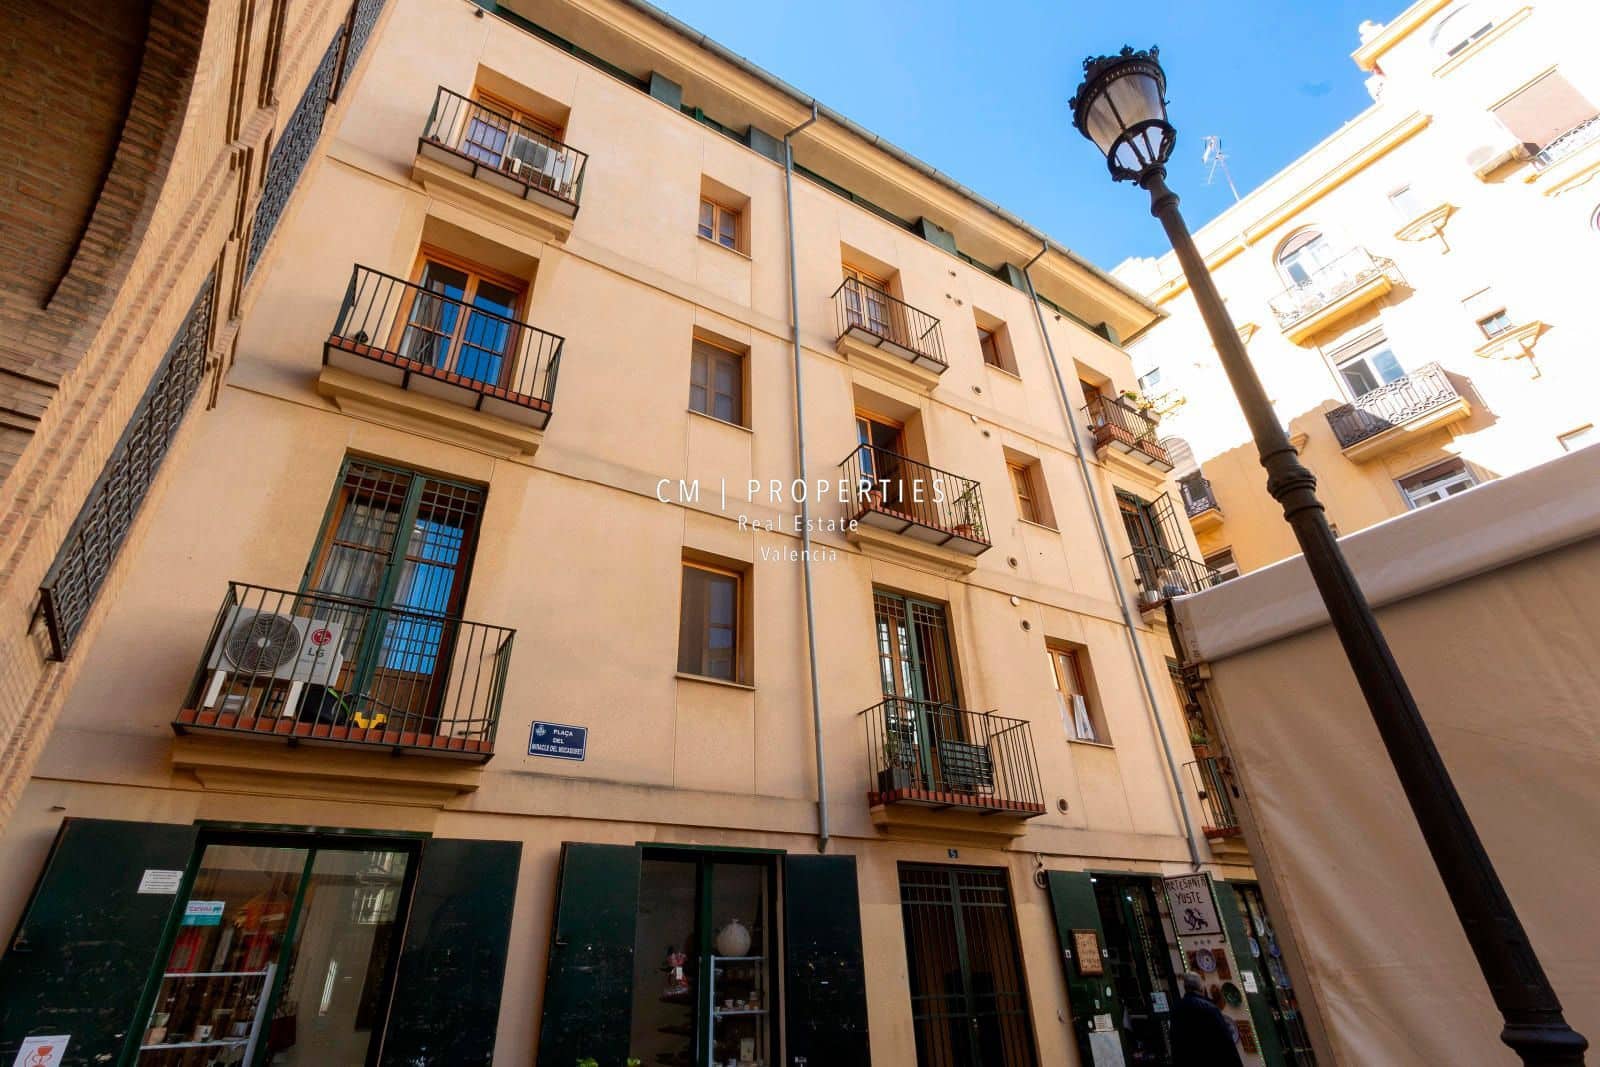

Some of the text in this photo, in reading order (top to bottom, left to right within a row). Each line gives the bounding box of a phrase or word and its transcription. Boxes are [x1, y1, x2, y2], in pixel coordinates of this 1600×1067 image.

[307, 647, 328, 657] LG
[553, 729, 573, 737] PLAÇA
[1175, 891, 1204, 905] YUSTE
